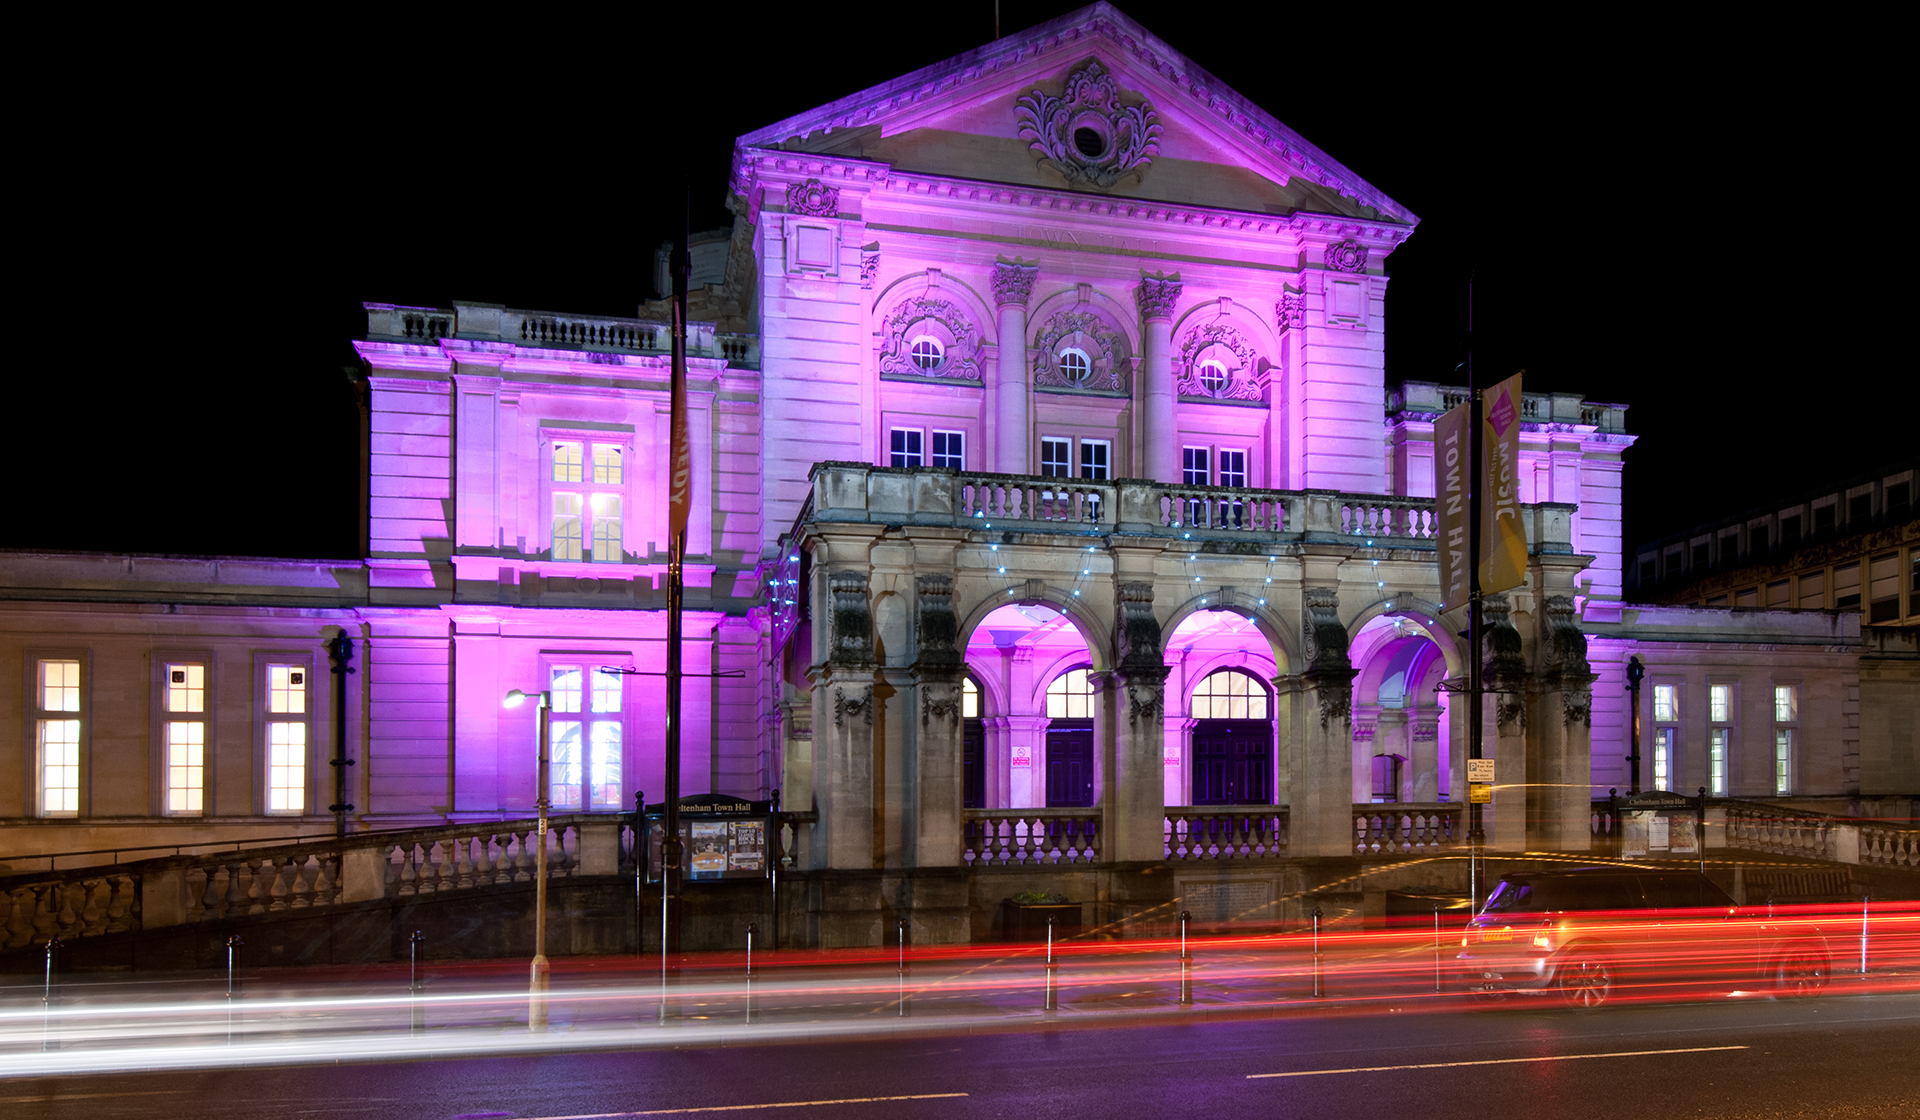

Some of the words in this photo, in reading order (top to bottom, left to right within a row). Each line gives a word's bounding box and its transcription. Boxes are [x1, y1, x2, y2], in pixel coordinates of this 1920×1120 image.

[1013, 226, 1082, 249] TOWN
[1099, 234, 1161, 258] HALL
[1446, 430, 1462, 516] TOWN
[1496, 442, 1515, 520] MUSIC
[1448, 526, 1462, 598] HALL
